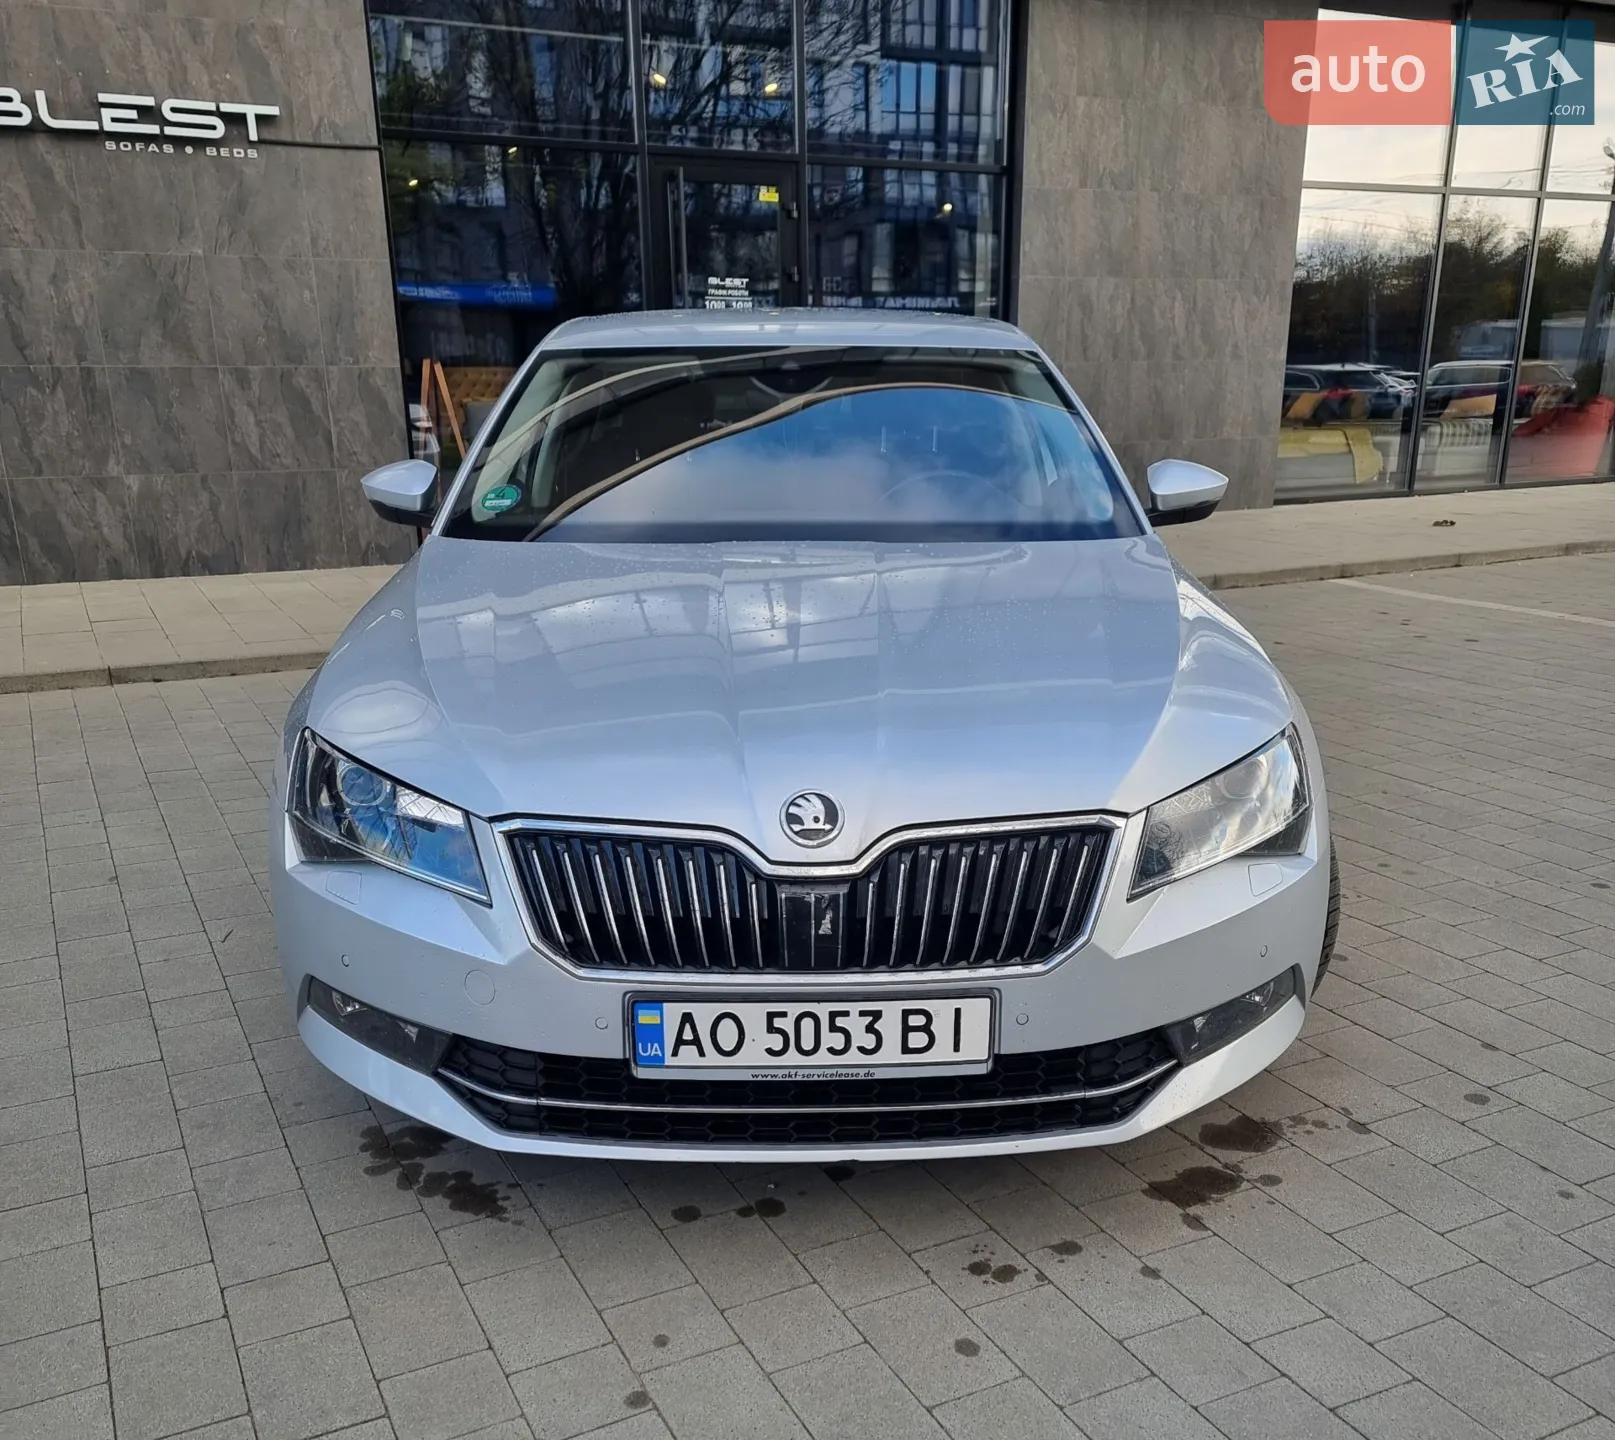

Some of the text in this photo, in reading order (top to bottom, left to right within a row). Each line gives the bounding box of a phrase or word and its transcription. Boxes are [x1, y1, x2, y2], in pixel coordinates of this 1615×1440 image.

[0, 86, 280, 142] BLEST
[105, 140, 259, 159] SOFAS BEDS
[670, 1011, 746, 1058] AO
[764, 1008, 884, 1058] 5053
[638, 1042, 662, 1058] UA
[750, 1070, 876, 1080] www.akf-servicelease.de
